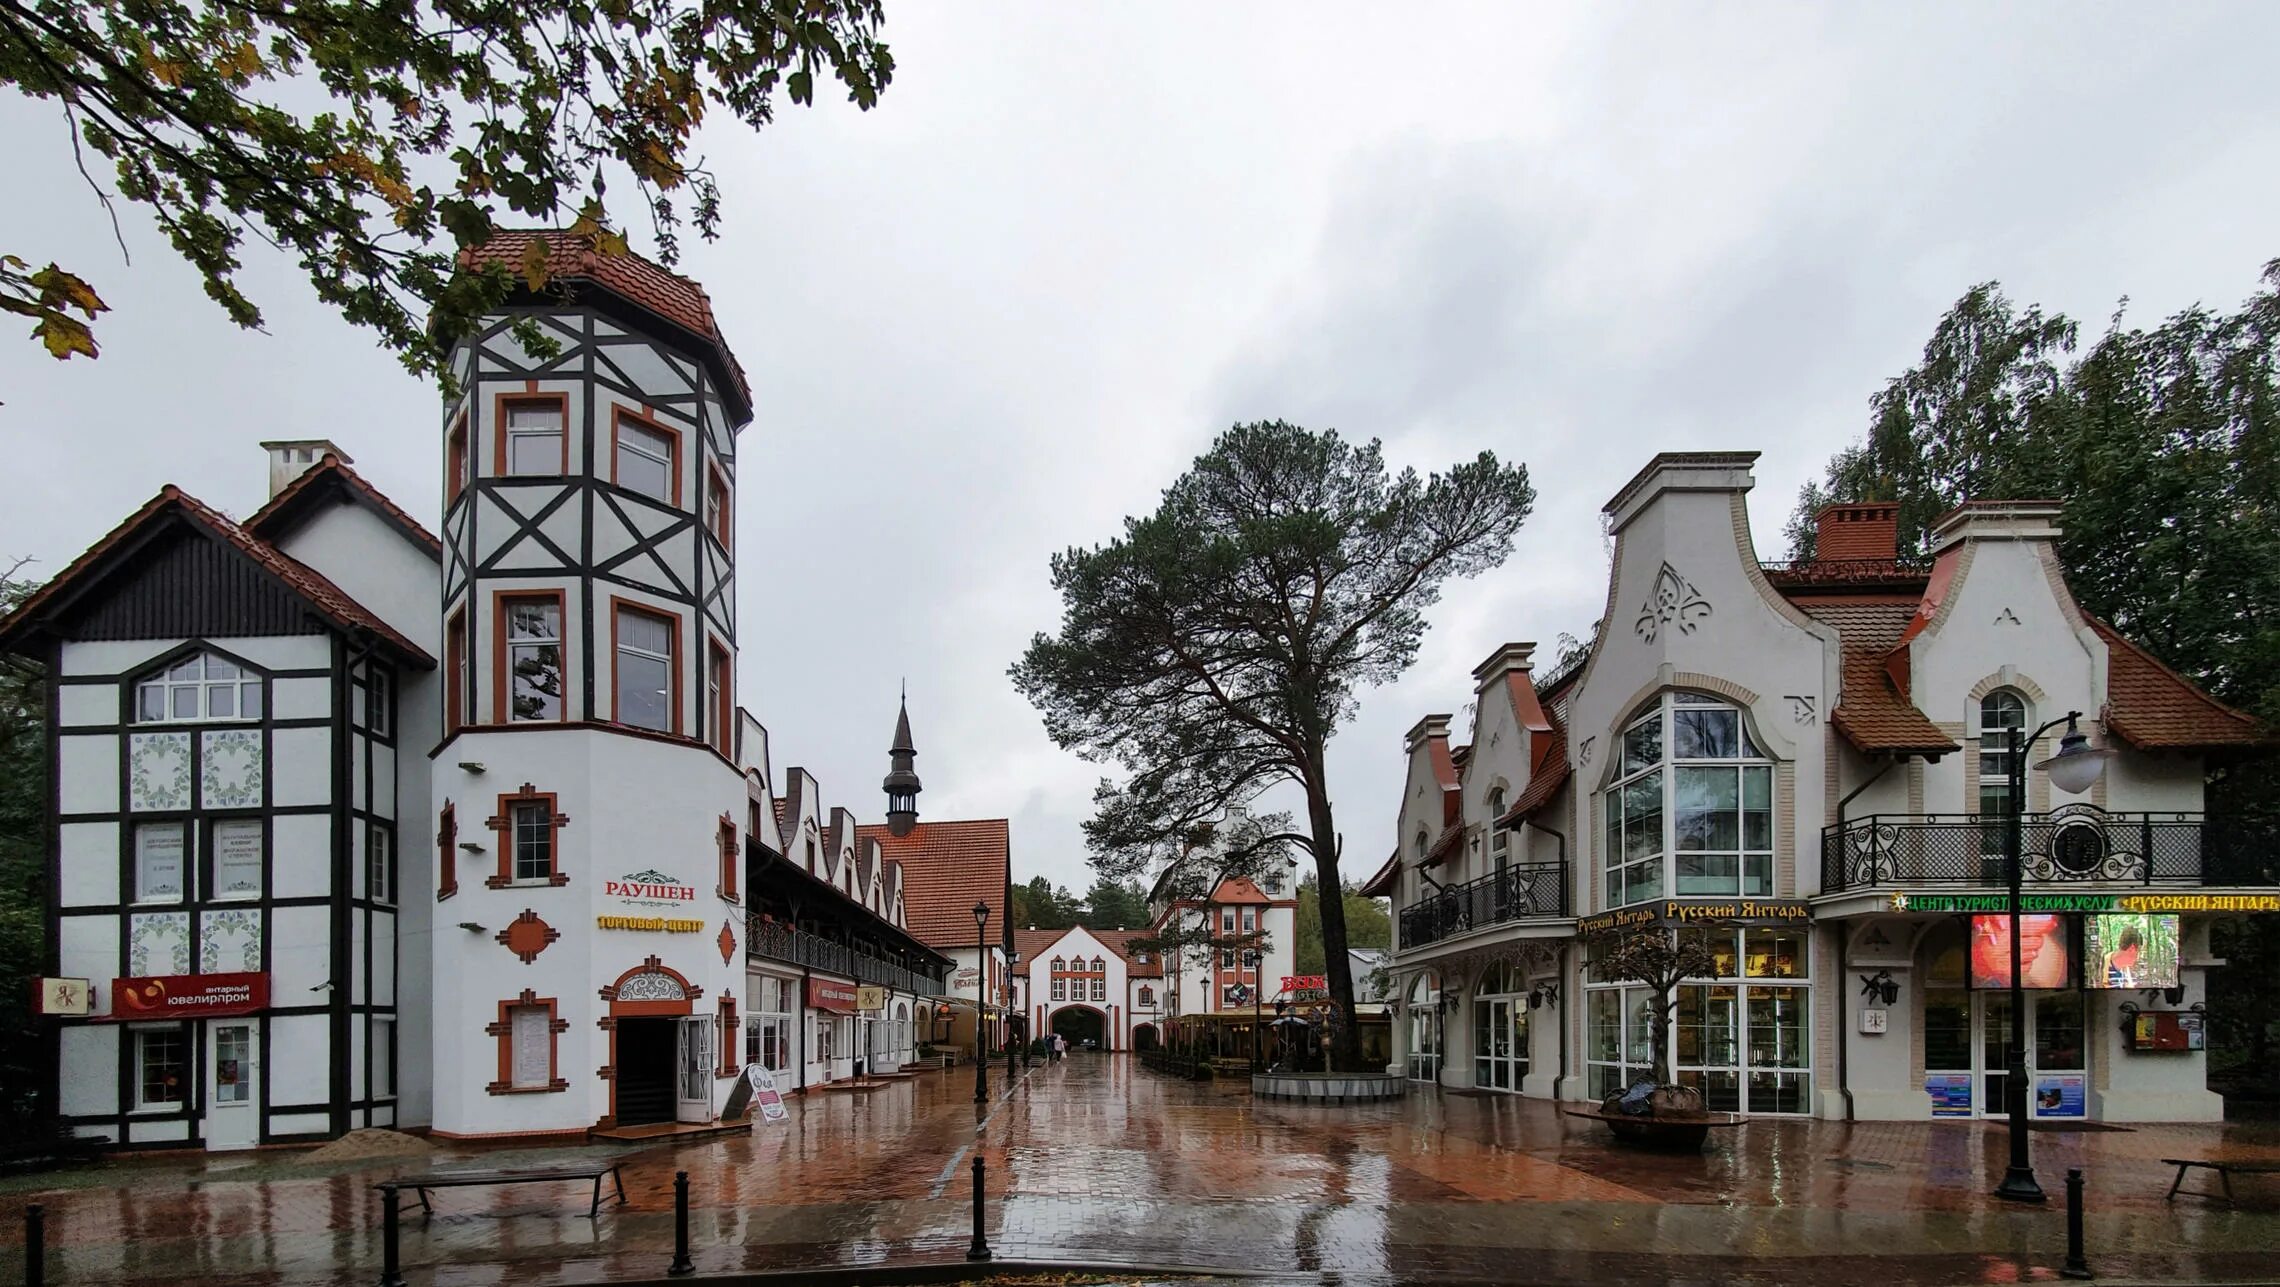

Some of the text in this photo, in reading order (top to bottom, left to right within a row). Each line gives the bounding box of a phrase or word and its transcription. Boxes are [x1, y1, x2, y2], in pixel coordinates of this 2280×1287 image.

[606, 881, 695, 900] РАУШЕН
[1908, 896, 2117, 910] ЦЕНТР ТУРИСТЧЕСКИХ УСЛУГ
[1667, 902, 1807, 922] Русский Янтарь
[597, 916, 705, 933] ТОРГОВЫЙ ЦЕНТР
[1578, 909, 1655, 935] Русский Янтарь
[205, 985, 250, 994] янтарный
[168, 993, 250, 1006] ювелирпром
